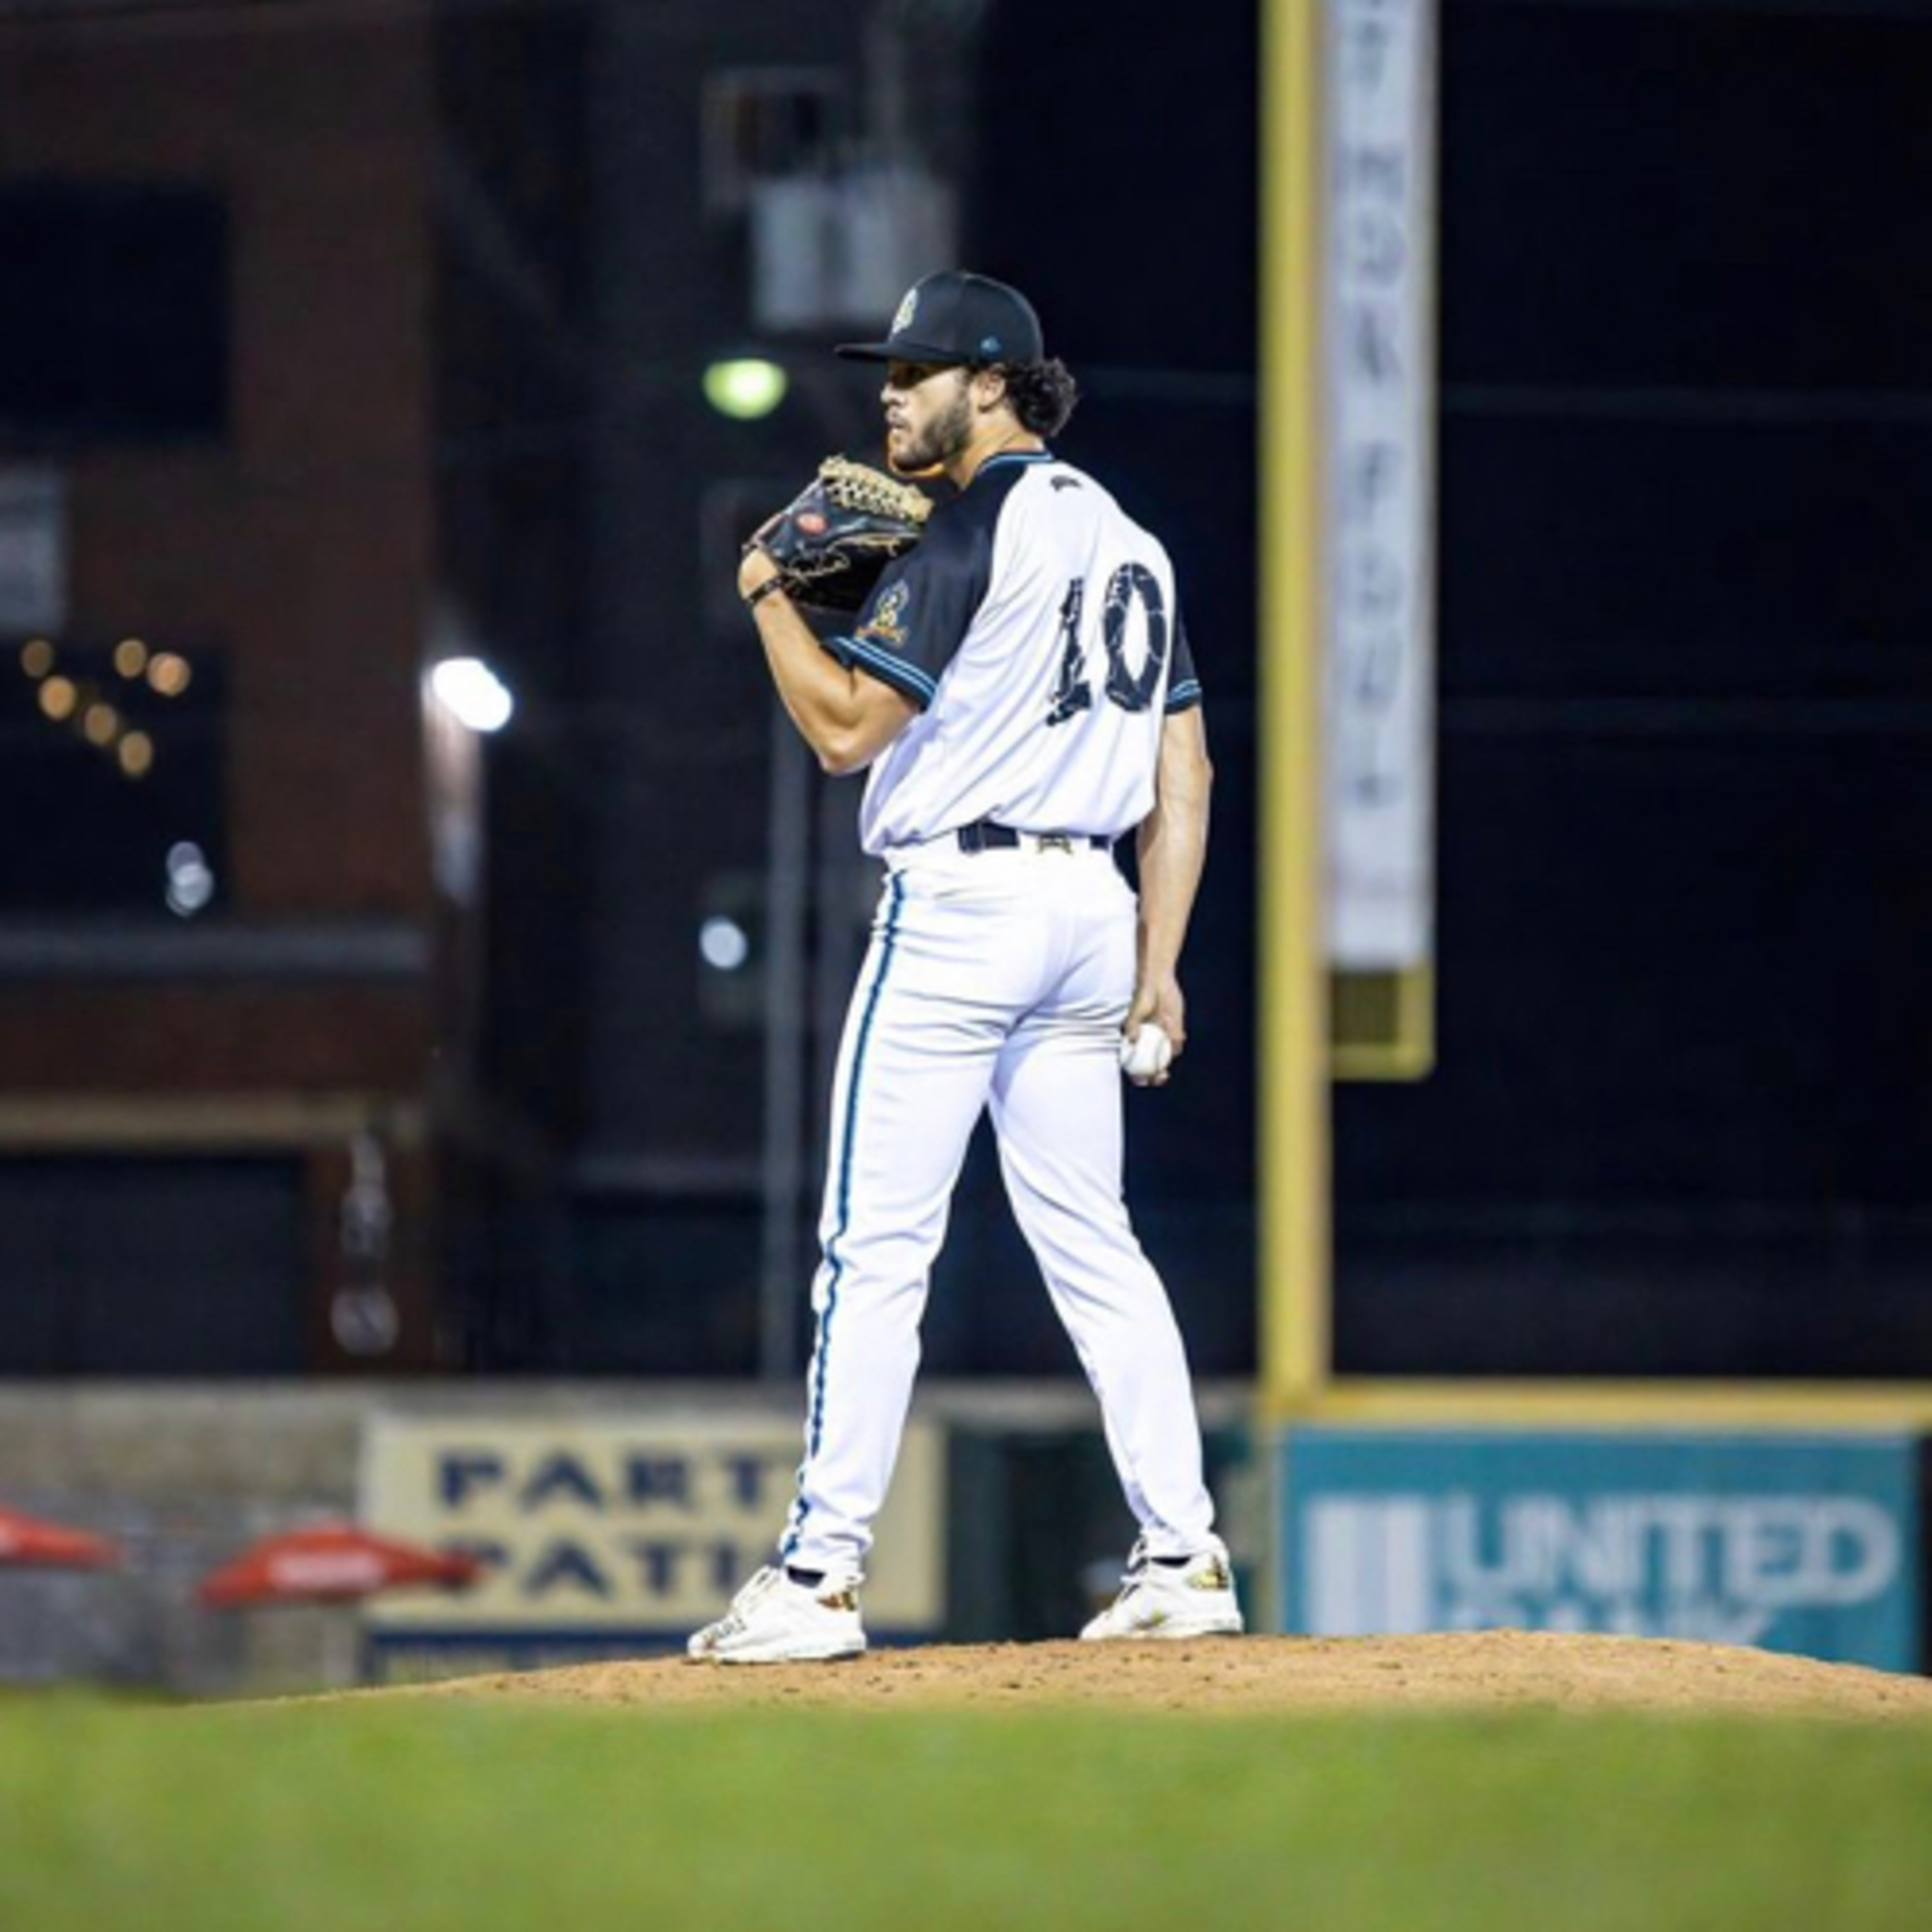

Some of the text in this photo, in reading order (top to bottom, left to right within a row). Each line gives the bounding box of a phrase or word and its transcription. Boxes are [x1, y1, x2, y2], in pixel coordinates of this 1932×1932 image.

[1046, 562, 1167, 726] 10
[437, 1449, 776, 1511] PART
[440, 1540, 739, 1598] PATI
[1440, 1495, 1900, 1605] UNITED
